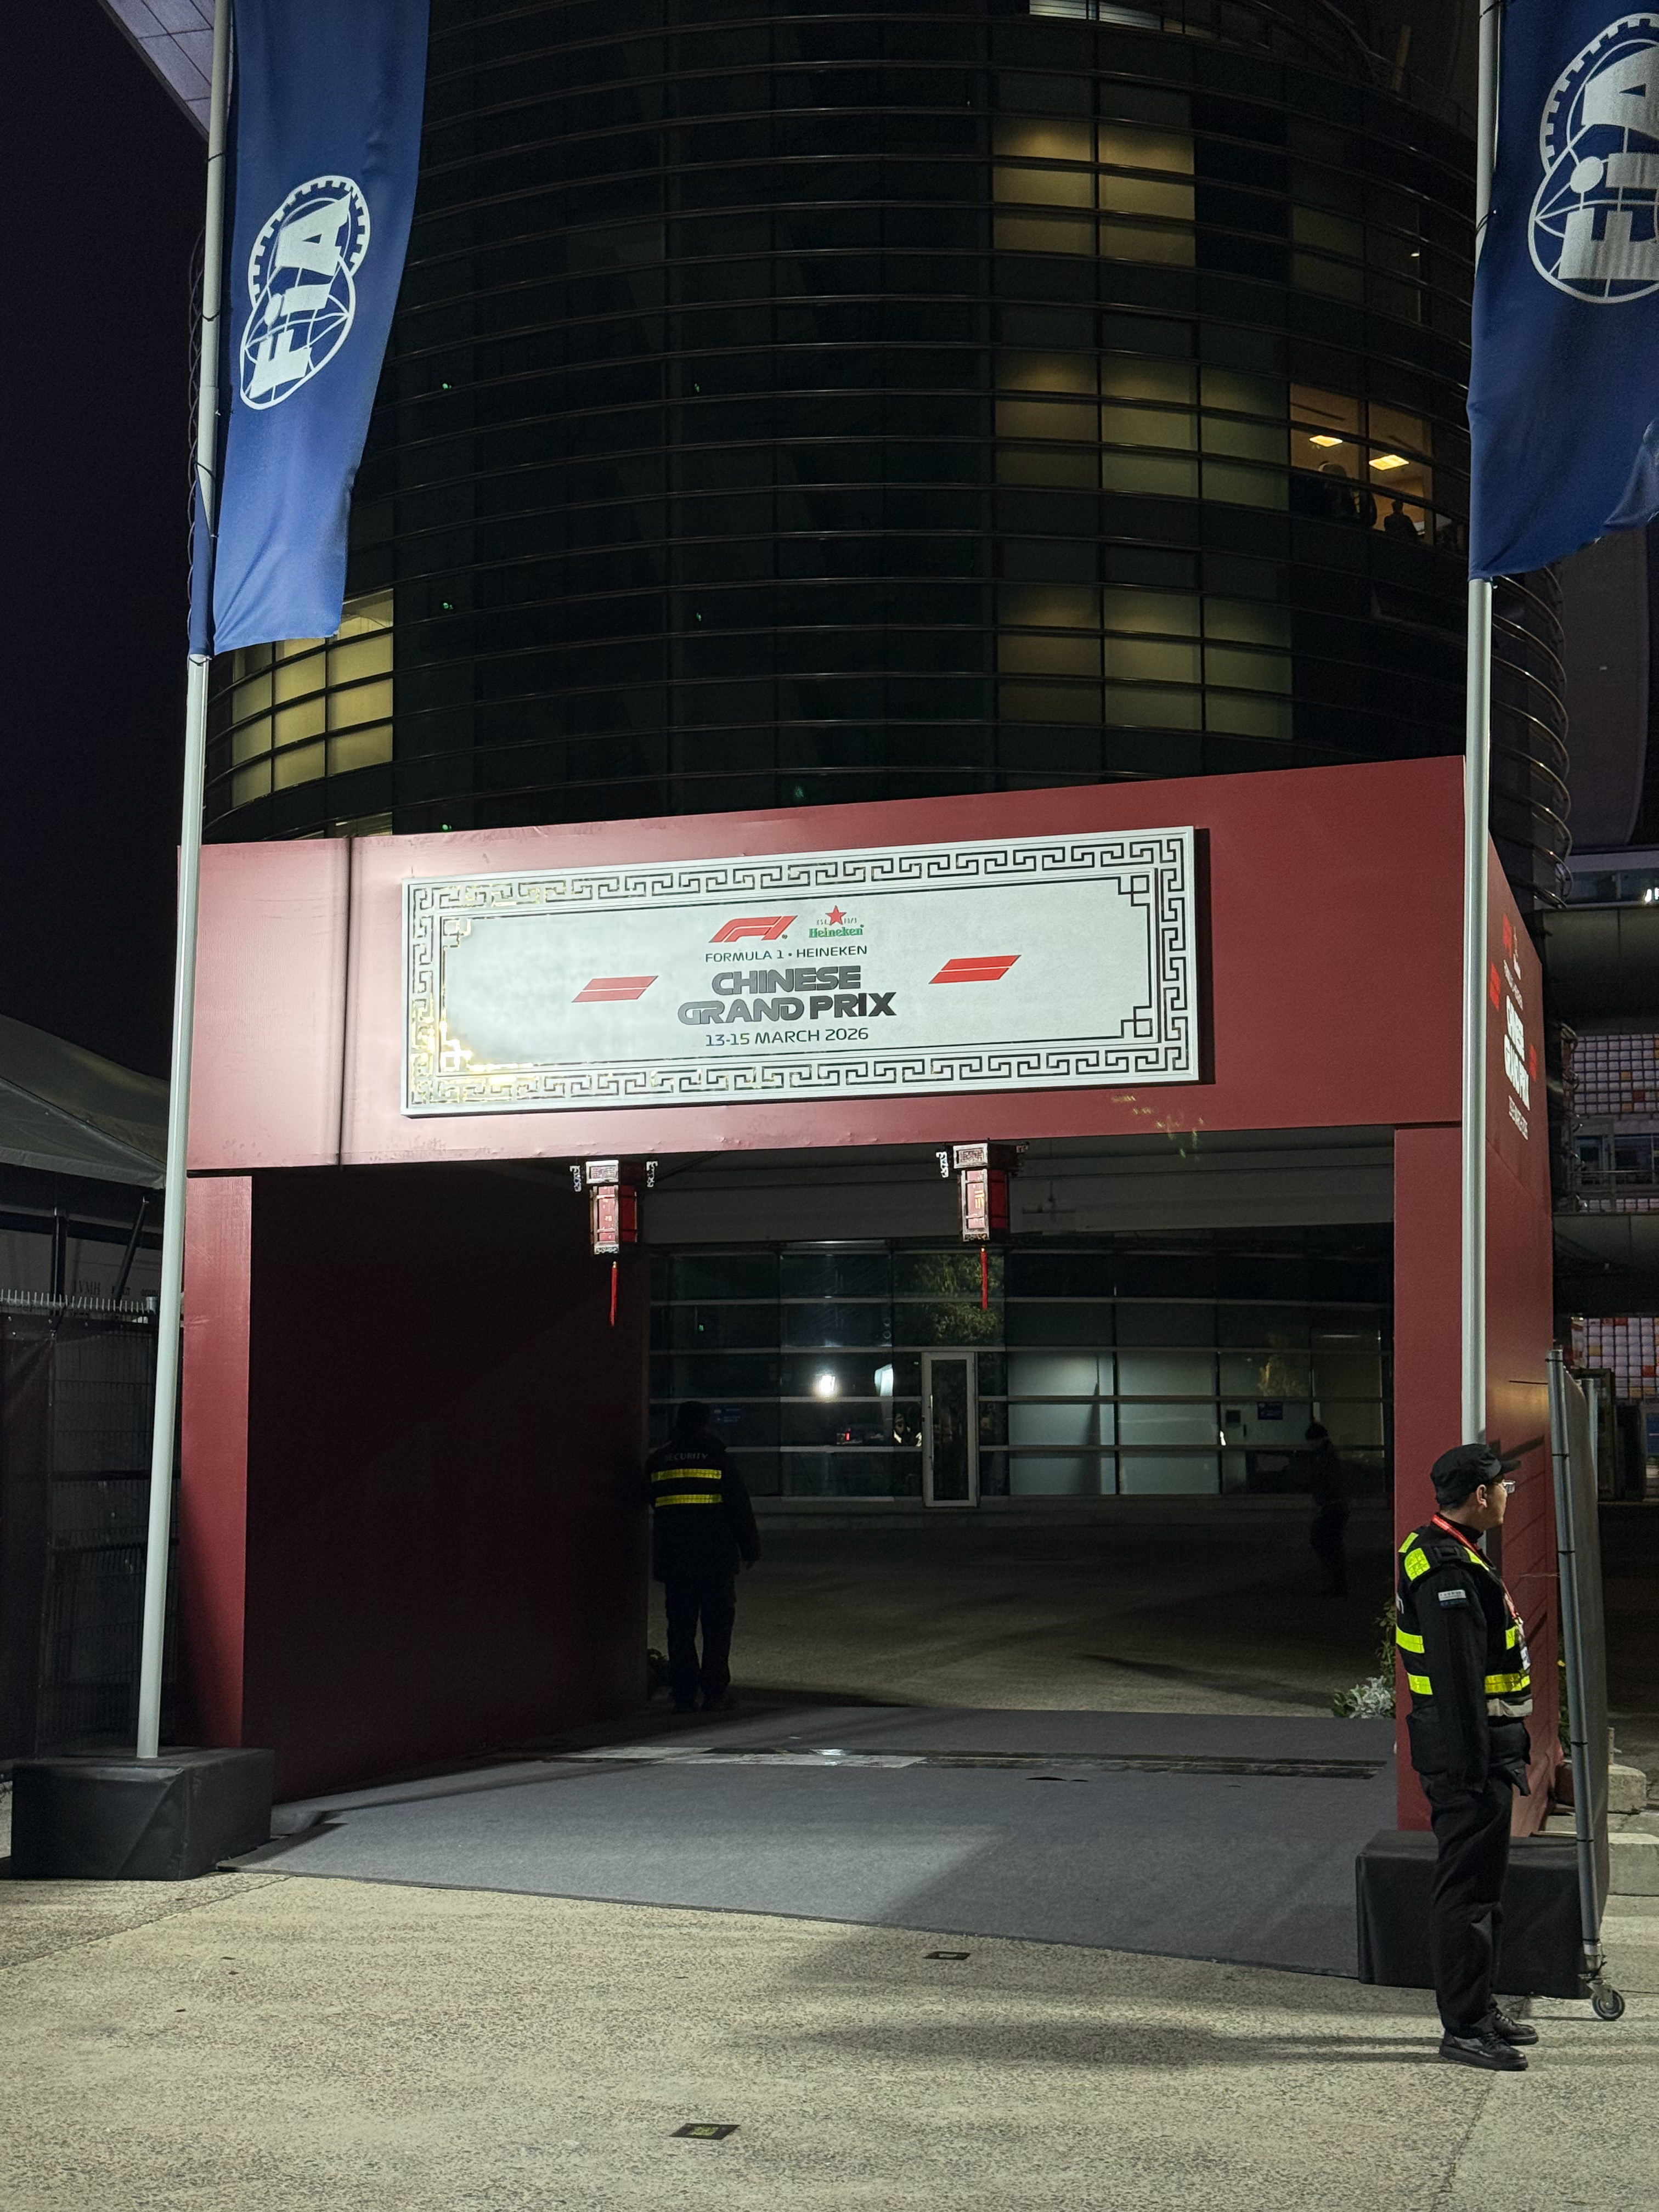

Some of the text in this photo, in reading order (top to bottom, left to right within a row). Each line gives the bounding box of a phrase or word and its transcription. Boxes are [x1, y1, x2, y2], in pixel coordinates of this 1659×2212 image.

[809, 926, 864, 938] Heineken
[706, 945, 867, 963] FORMULA 1 HEINEKEN
[712, 965, 861, 996] CHINESE
[678, 991, 897, 1025] GRAND PRIX
[705, 1028, 869, 1047] 13-15 MARCH 2026
[664, 1452, 709, 1462] SECURITY
